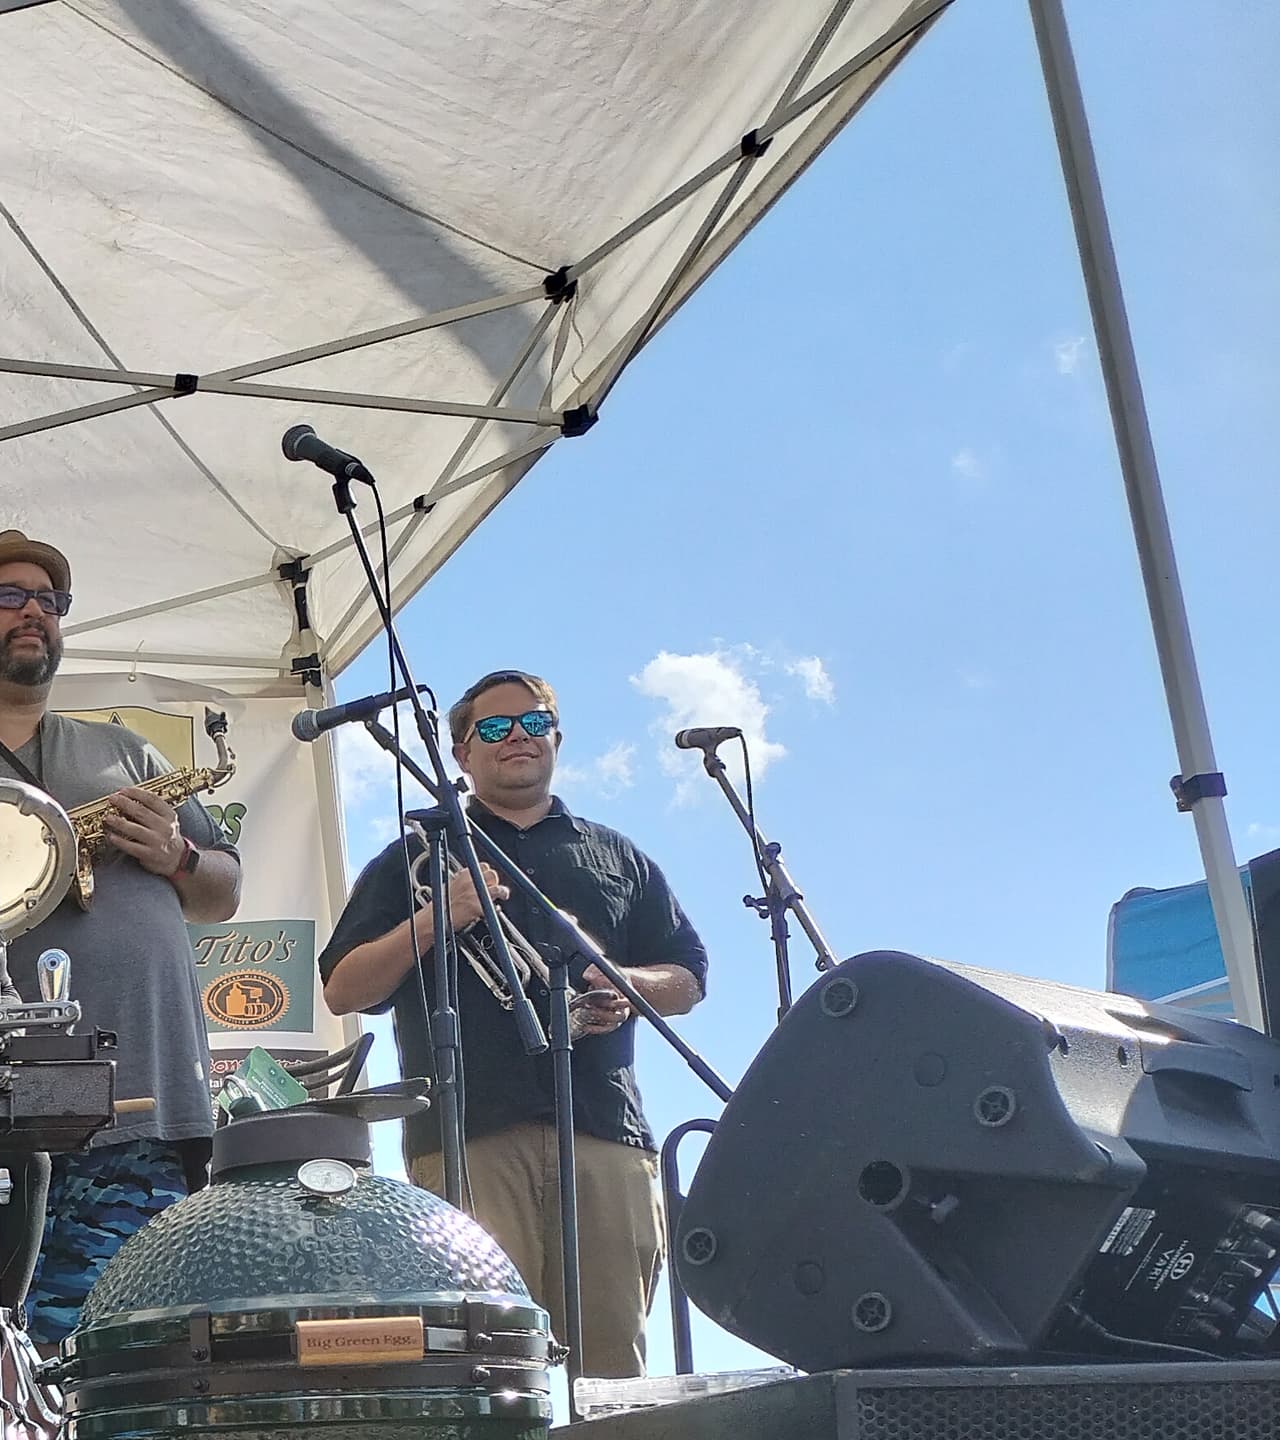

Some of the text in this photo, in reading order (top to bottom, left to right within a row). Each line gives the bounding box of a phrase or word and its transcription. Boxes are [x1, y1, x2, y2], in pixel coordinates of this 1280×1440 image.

[195, 930, 297, 968] Tito's
[306, 1338, 332, 1350] Big
[334, 1336, 381, 1348] Green
